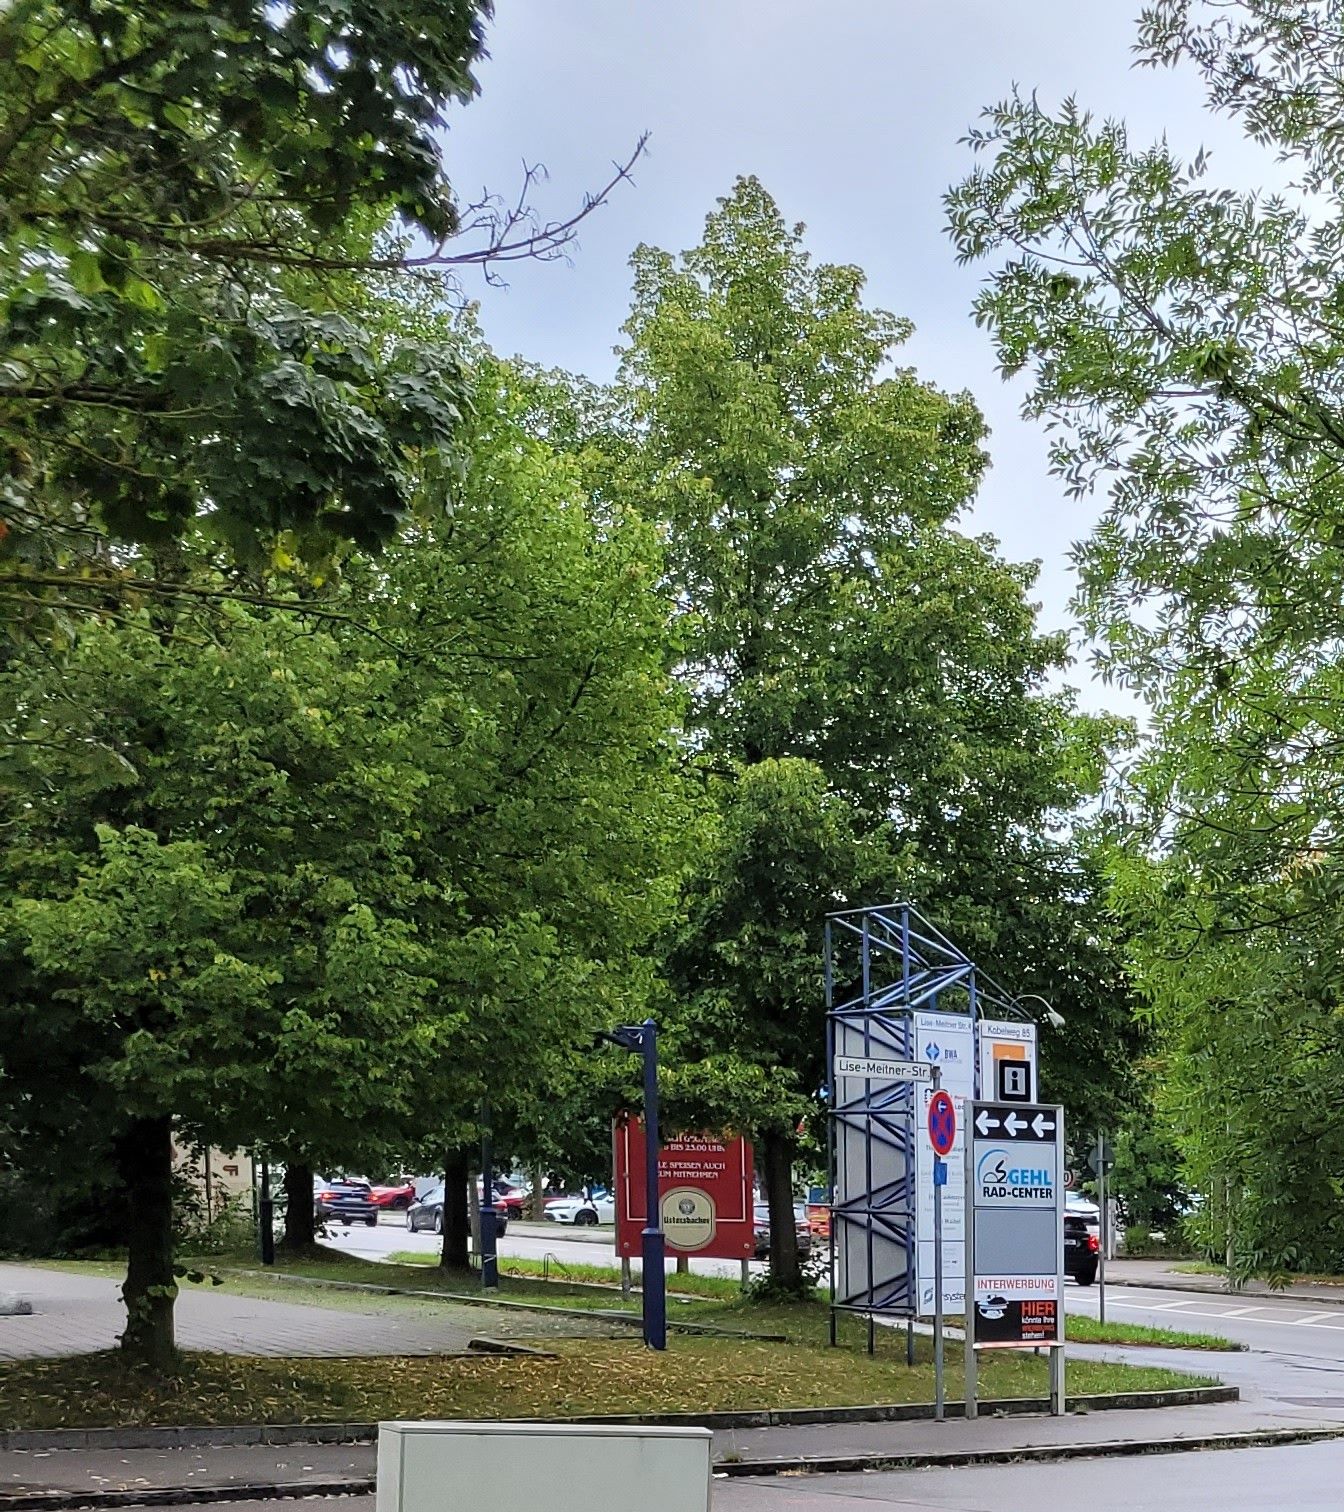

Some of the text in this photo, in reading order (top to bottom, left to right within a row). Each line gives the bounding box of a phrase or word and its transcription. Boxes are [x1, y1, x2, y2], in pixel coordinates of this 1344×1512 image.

[839, 1060, 931, 1077] Lise-Meitner-Str.
[1008, 1168, 1052, 1186] GEHL
[983, 1186, 1053, 1199] RAD-CENTER
[977, 1279, 1055, 1290] INTERWERBUNG
[1021, 1301, 1055, 1317] HIER
